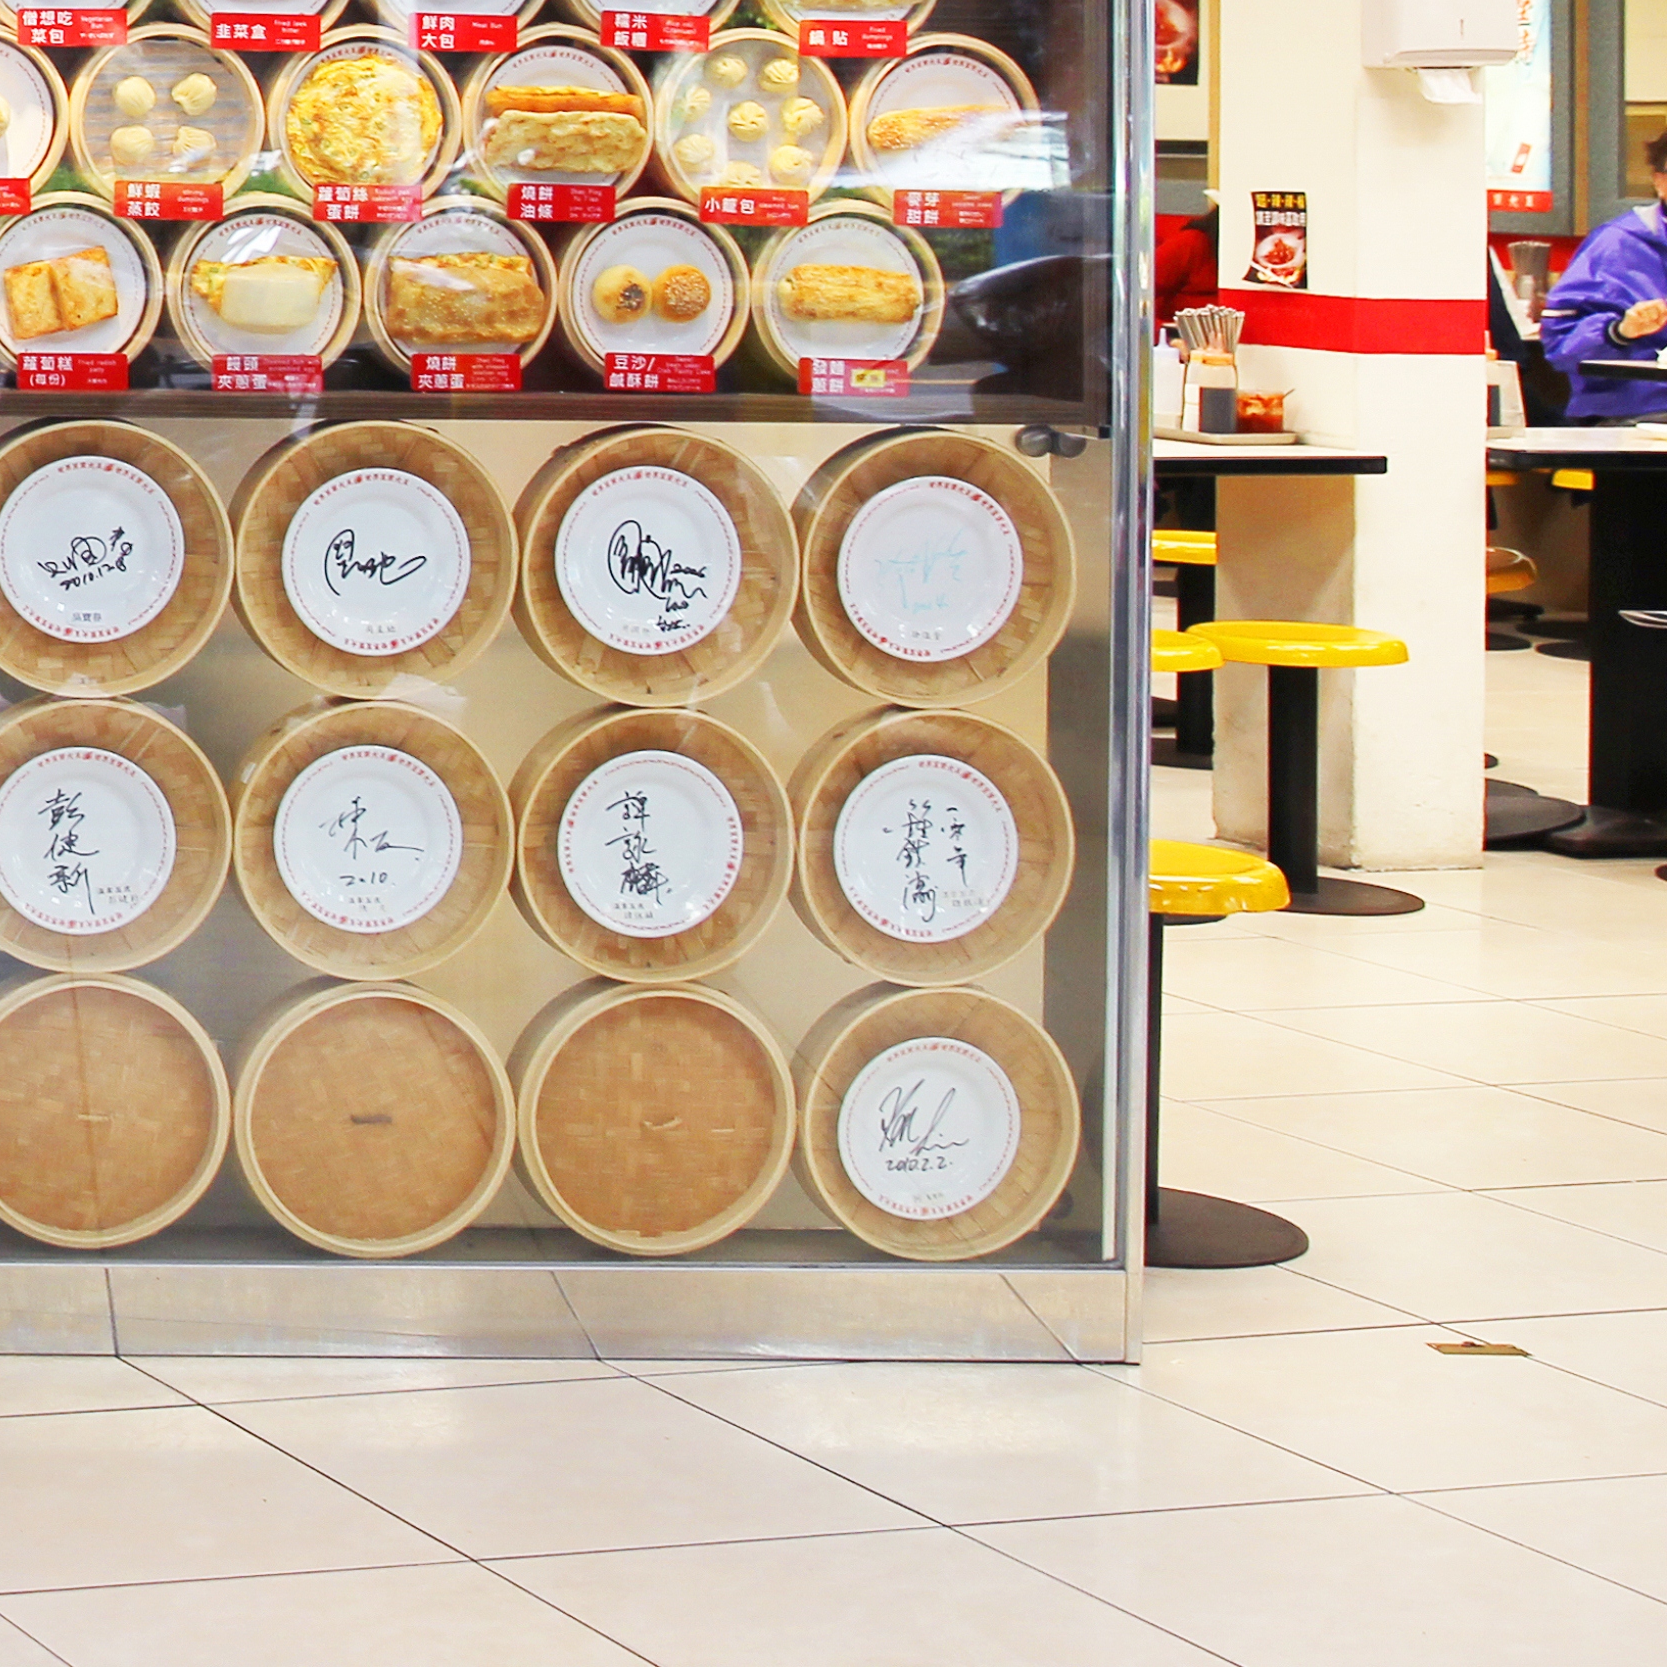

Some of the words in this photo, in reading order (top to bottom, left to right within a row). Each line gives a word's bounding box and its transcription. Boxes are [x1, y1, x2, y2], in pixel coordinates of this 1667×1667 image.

[421, 15, 456, 31] 鮮肉
[30, 28, 65, 45] 菜包
[421, 33, 455, 49] 大包
[808, 29, 849, 46] 鍋貼
[127, 183, 161, 199] 鮮蝦
[520, 185, 554, 201] 燒餅
[126, 201, 160, 217] 蒸餃
[325, 203, 360, 220] 蛋餅
[520, 203, 554, 220] 油條
[704, 197, 755, 215] 小籠包
[21, 355, 74, 372] 蘿蔔糕
[226, 356, 259, 371] 饅頭
[425, 355, 457, 371] 燒餅
[28, 372, 67, 387] (每份)
